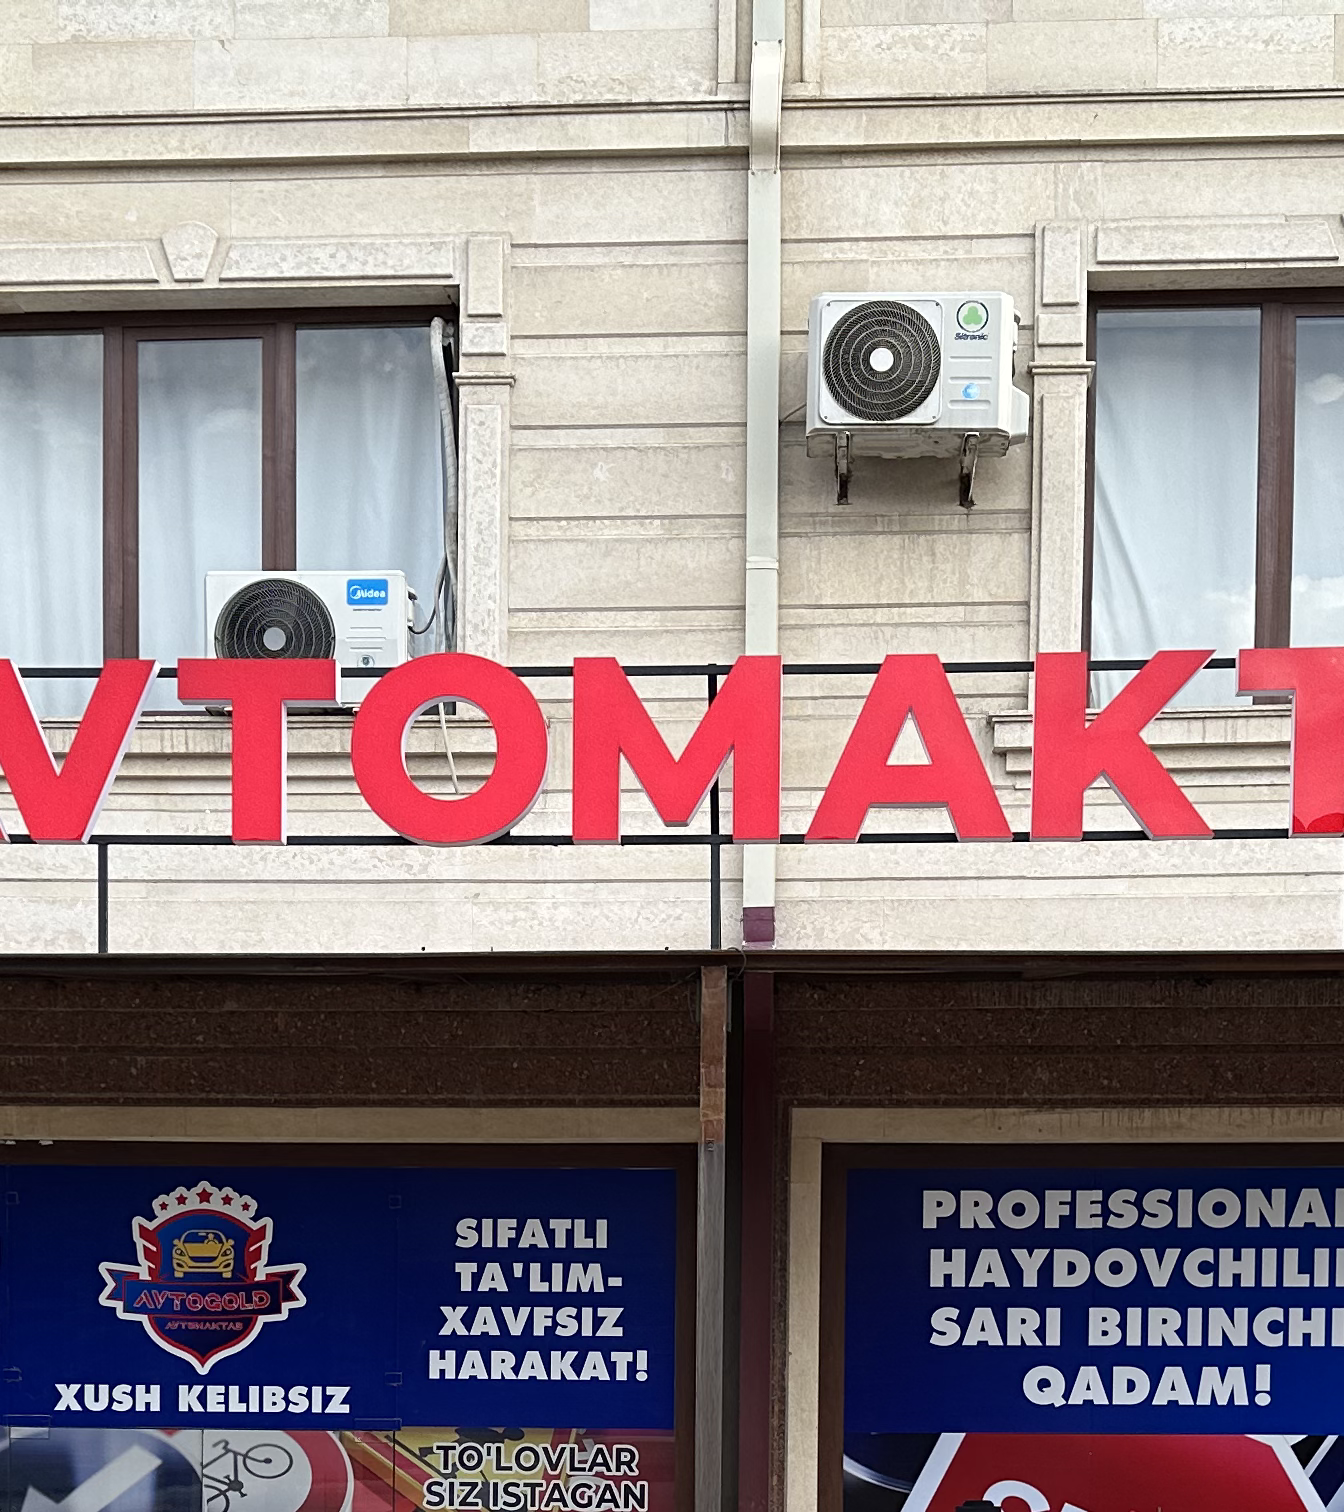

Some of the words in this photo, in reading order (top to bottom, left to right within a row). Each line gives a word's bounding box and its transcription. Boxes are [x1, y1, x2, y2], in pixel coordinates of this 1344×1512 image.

[350, 585, 386, 599] Midea
[455, 1218, 608, 1250] SIFATLI
[454, 1262, 623, 1293] TA'LIM-
[133, 1289, 271, 1312] AVTOGOLD
[438, 1306, 624, 1338] XAVFSIZ
[929, 1307, 1062, 1347] SARI
[428, 1350, 650, 1382] HARAKAT!
[54, 1383, 161, 1413] XUSH
[177, 1385, 352, 1414] KELIBSIZ
[1022, 1364, 1272, 1408] QADAM!
[435, 1445, 636, 1474] TO'LOVLAR
[424, 1480, 479, 1508] SIZ
[490, 1481, 646, 1510] ISTAGAN
